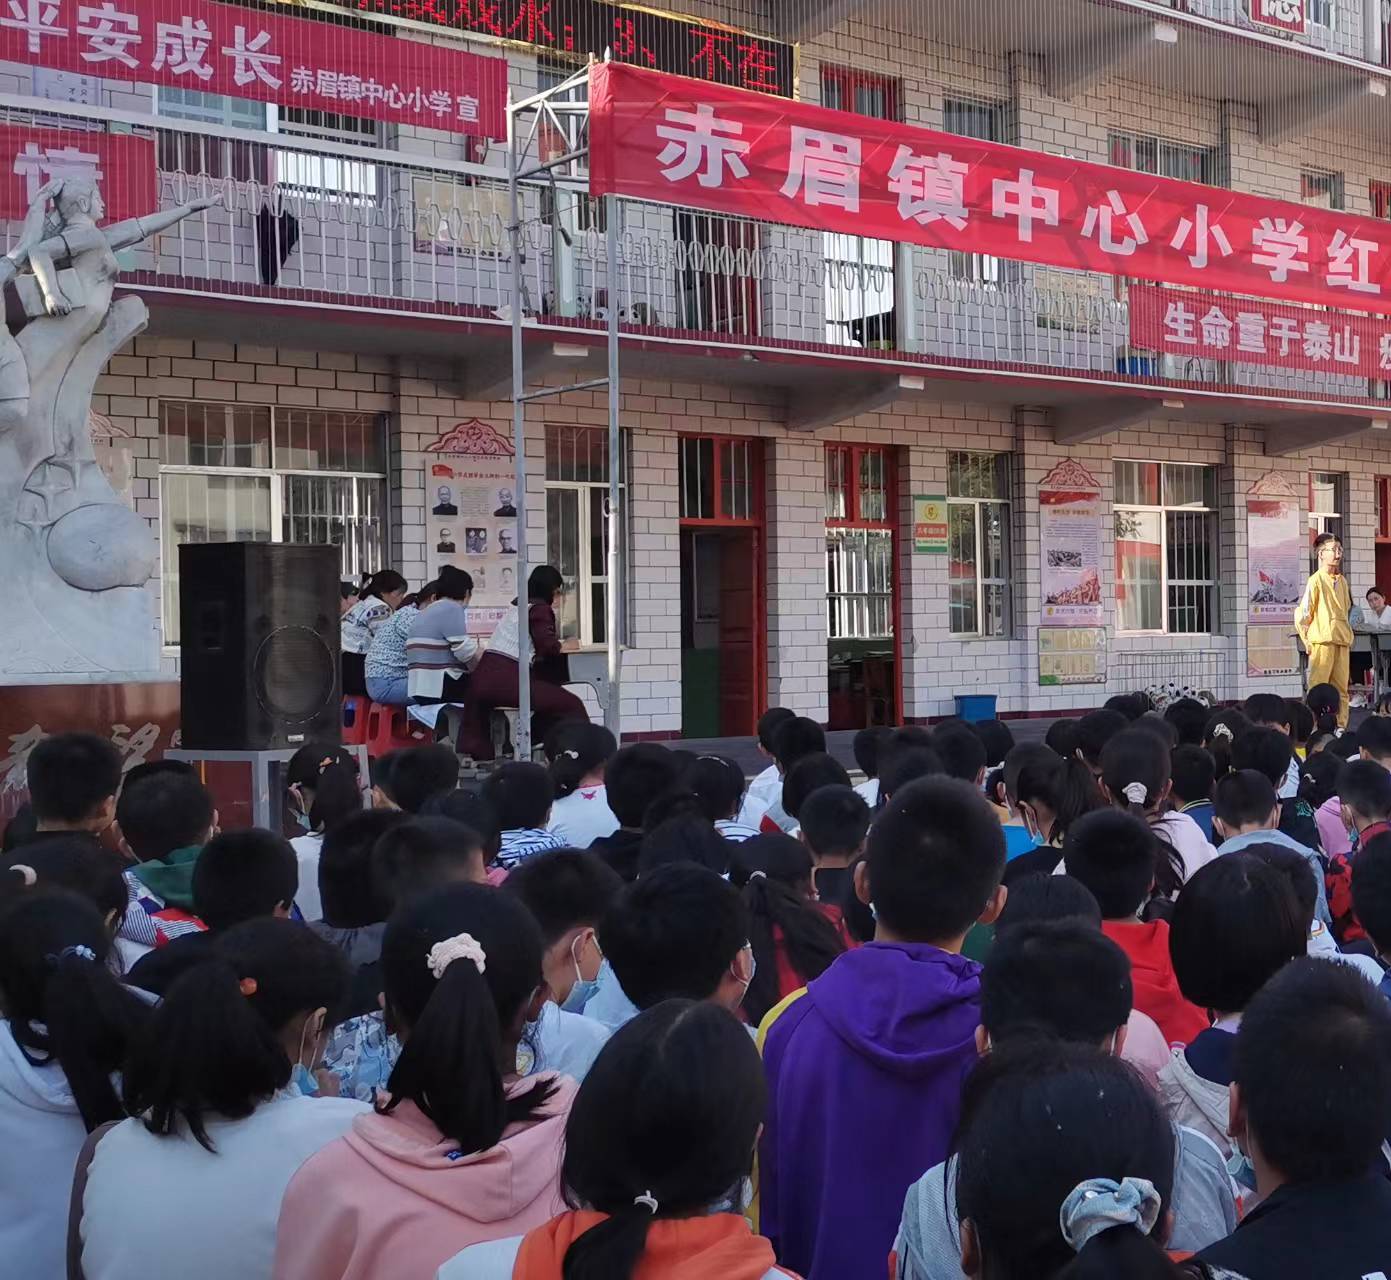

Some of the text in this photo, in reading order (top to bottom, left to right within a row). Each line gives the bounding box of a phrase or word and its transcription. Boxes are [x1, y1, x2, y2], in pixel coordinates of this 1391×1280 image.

[0, 0, 283, 90] 平安成长
[1163, 301, 1360, 365] 生命重于泰山
